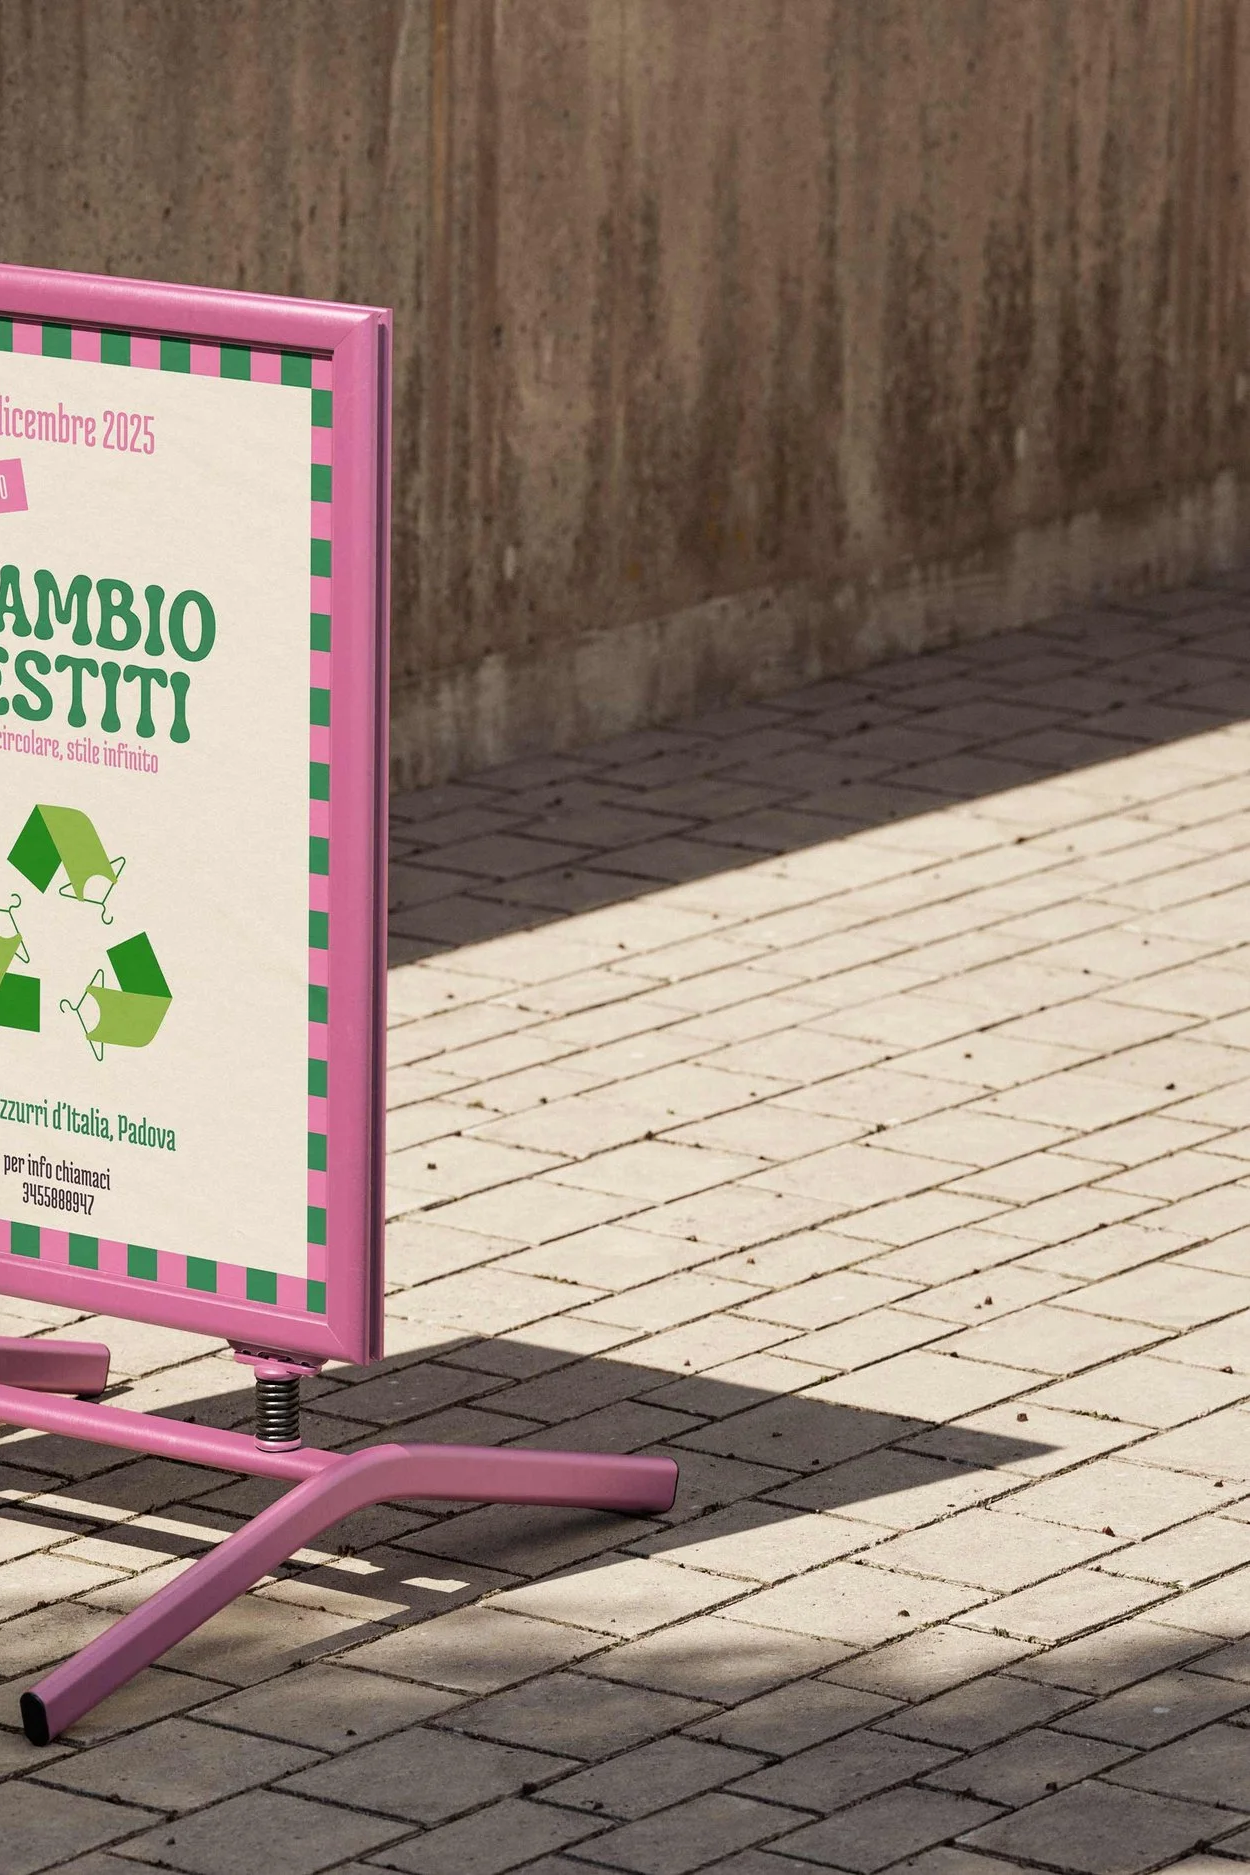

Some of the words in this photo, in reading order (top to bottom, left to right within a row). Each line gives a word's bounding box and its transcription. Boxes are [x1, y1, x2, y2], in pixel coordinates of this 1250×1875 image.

[103, 411, 155, 455] 2025
[67, 738, 100, 764] stile
[103, 741, 159, 773] infinito
[118, 1114, 177, 1151] Padova
[3, 1154, 25, 1175] per
[28, 1153, 53, 1179] info
[55, 1160, 111, 1191] chiamaci
[22, 1182, 95, 1216] 3455888947
